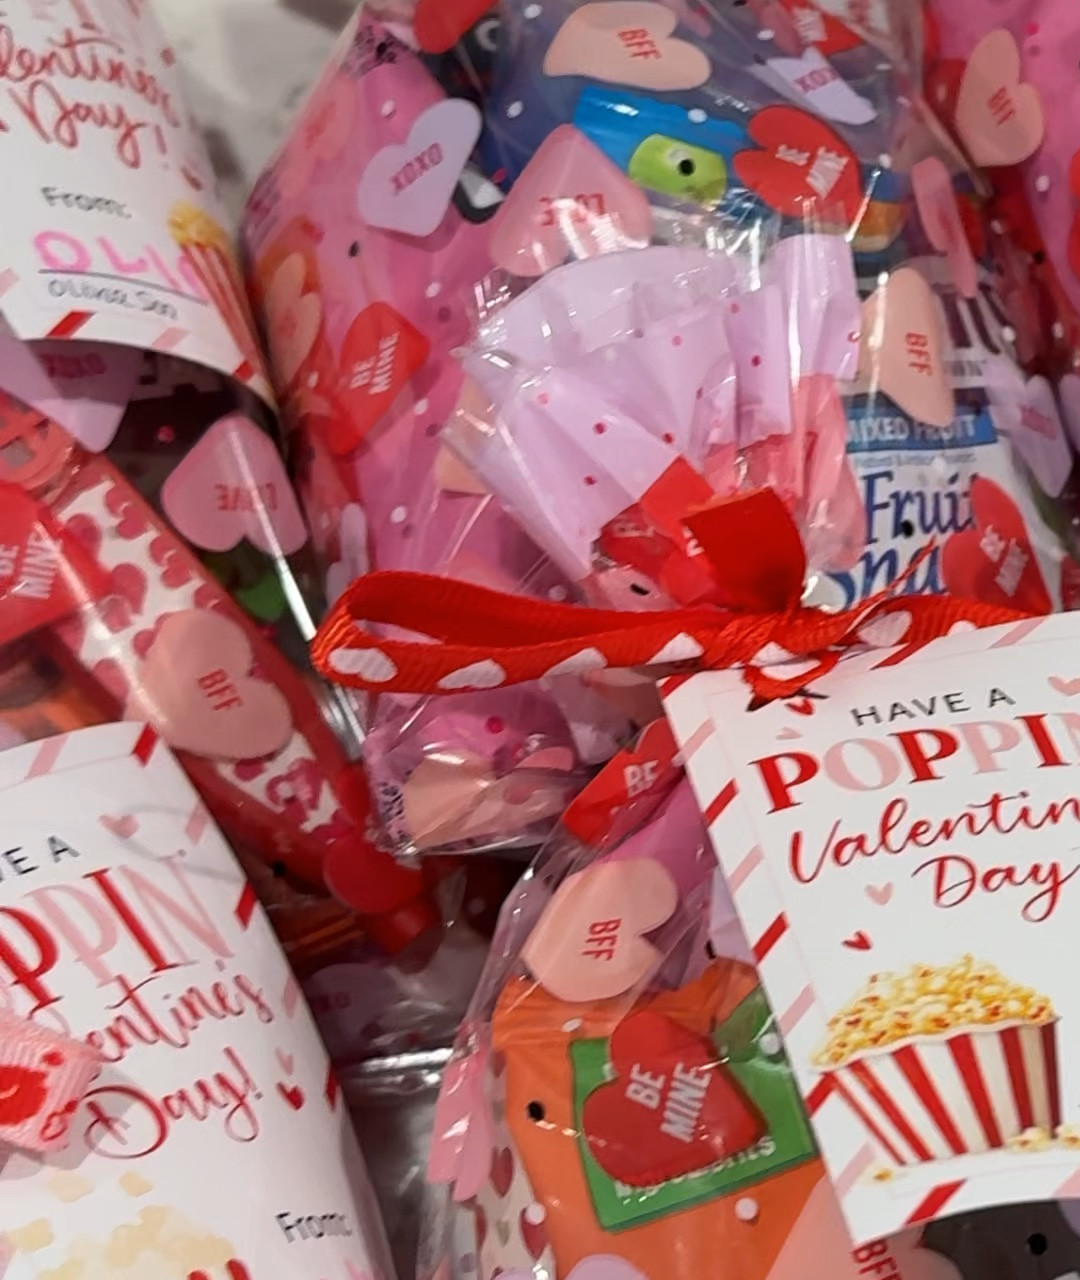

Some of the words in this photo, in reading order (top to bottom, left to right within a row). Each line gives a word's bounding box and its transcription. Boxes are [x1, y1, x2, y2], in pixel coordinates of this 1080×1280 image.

[619, 28, 661, 63] BFF
[389, 142, 443, 195] XOXO
[349, 360, 374, 391] BE
[369, 333, 400, 396] MINE
[905, 330, 932, 377] BFF
[197, 668, 245, 712] BFF
[851, 692, 970, 727] HAVE
[986, 687, 1016, 709] A
[48, 835, 79, 863] A
[581, 917, 623, 962] BFF
[84, 1047, 263, 1160] Day!
[626, 1063, 667, 1109] BE
[660, 1063, 713, 1144] MINE
